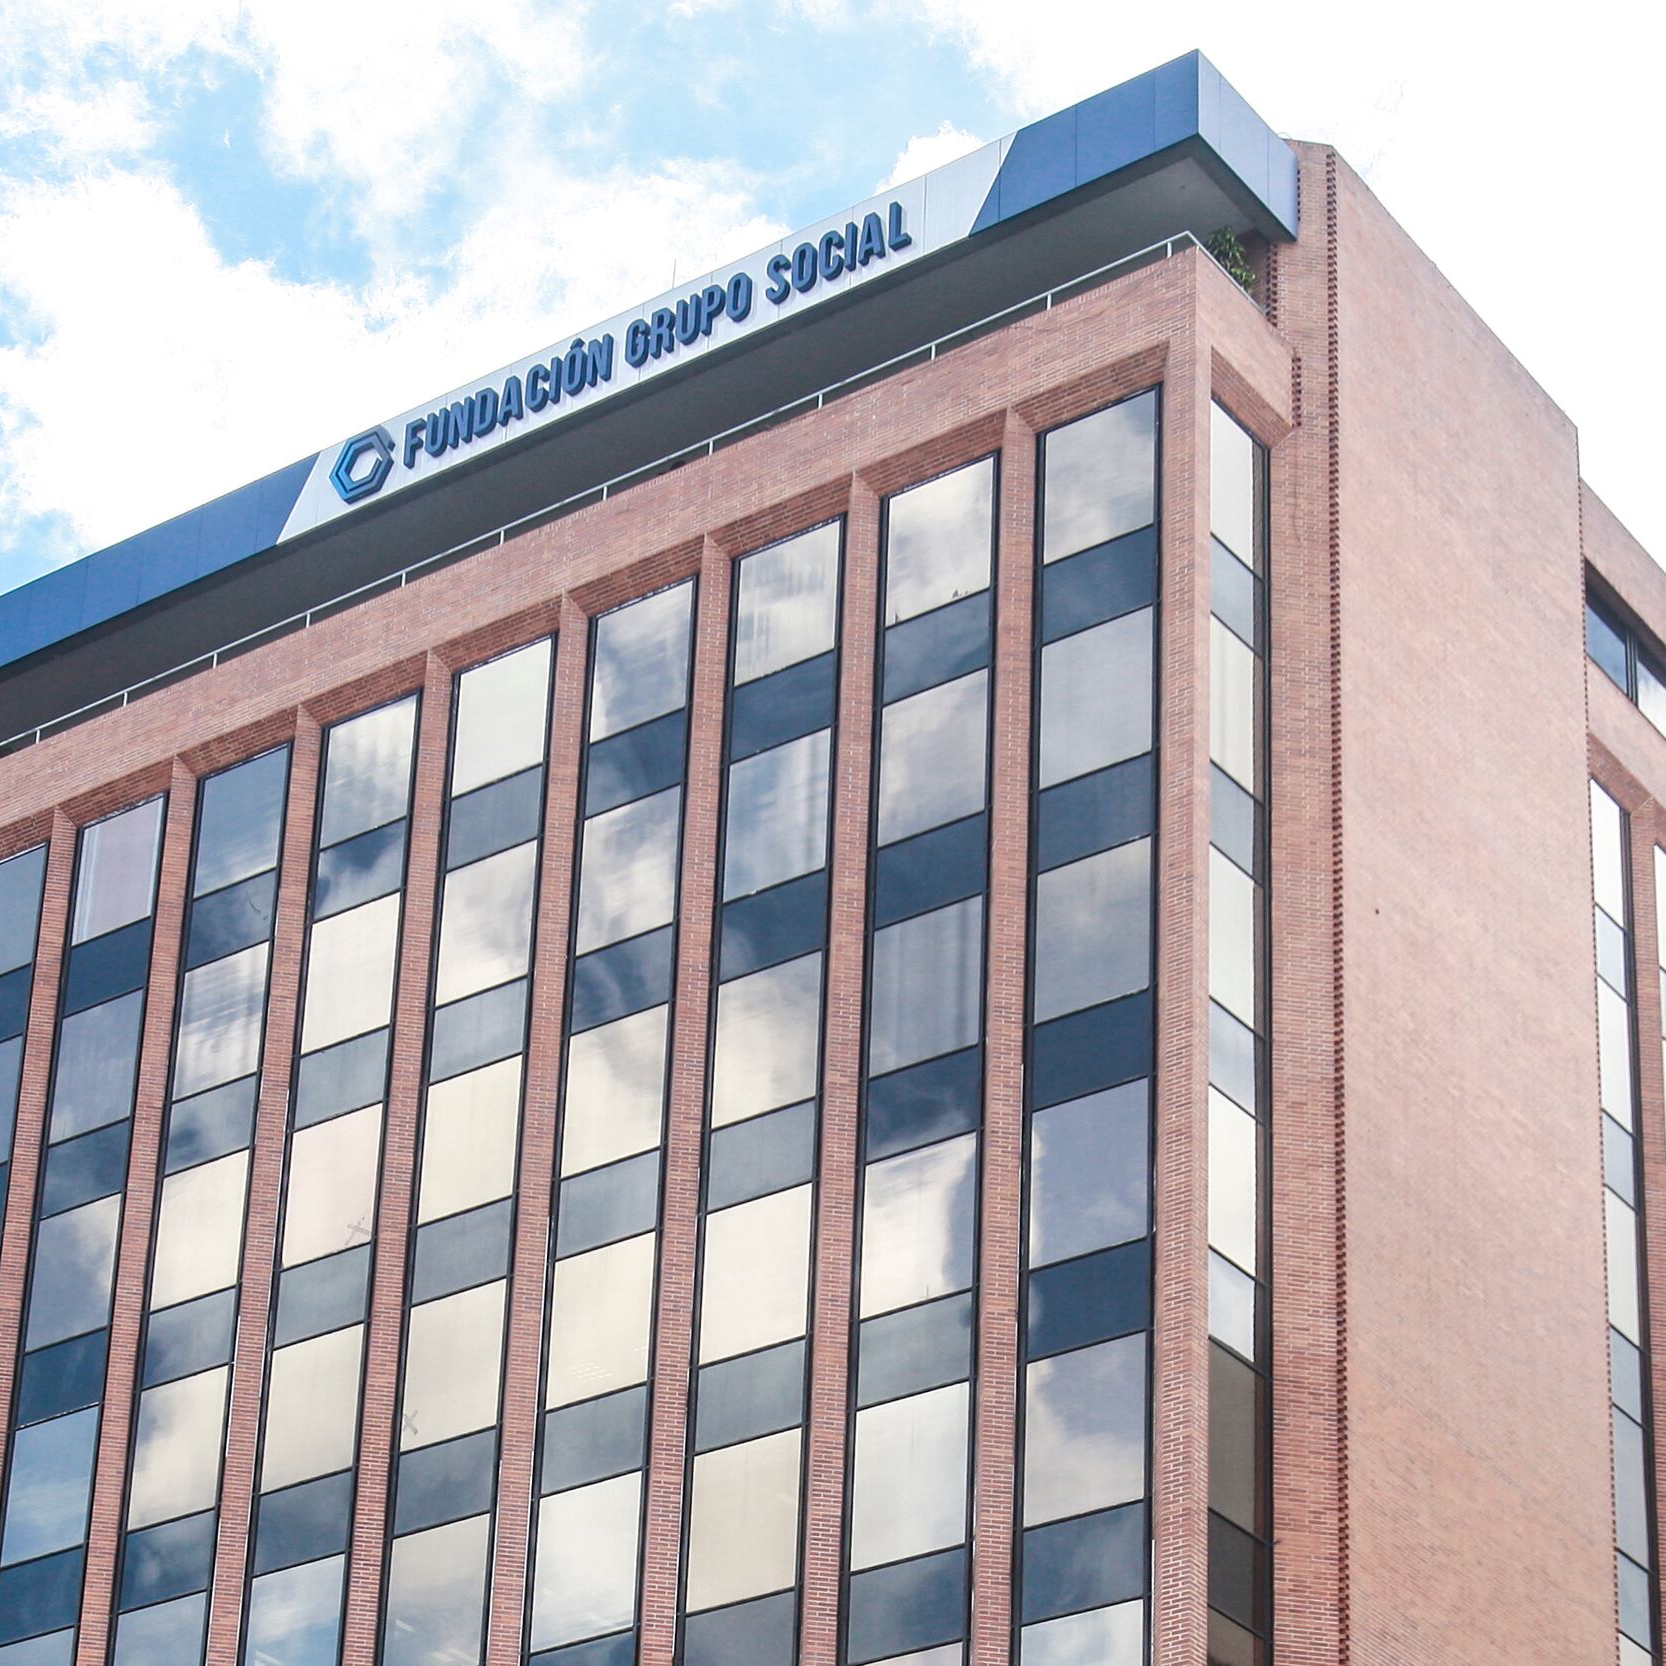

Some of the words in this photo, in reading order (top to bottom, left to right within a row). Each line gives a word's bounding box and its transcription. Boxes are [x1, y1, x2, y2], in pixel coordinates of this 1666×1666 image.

[403, 333, 614, 469] FUNDACIÓN
[624, 272, 752, 368] GRUPO
[765, 201, 912, 305] SOCIAL
